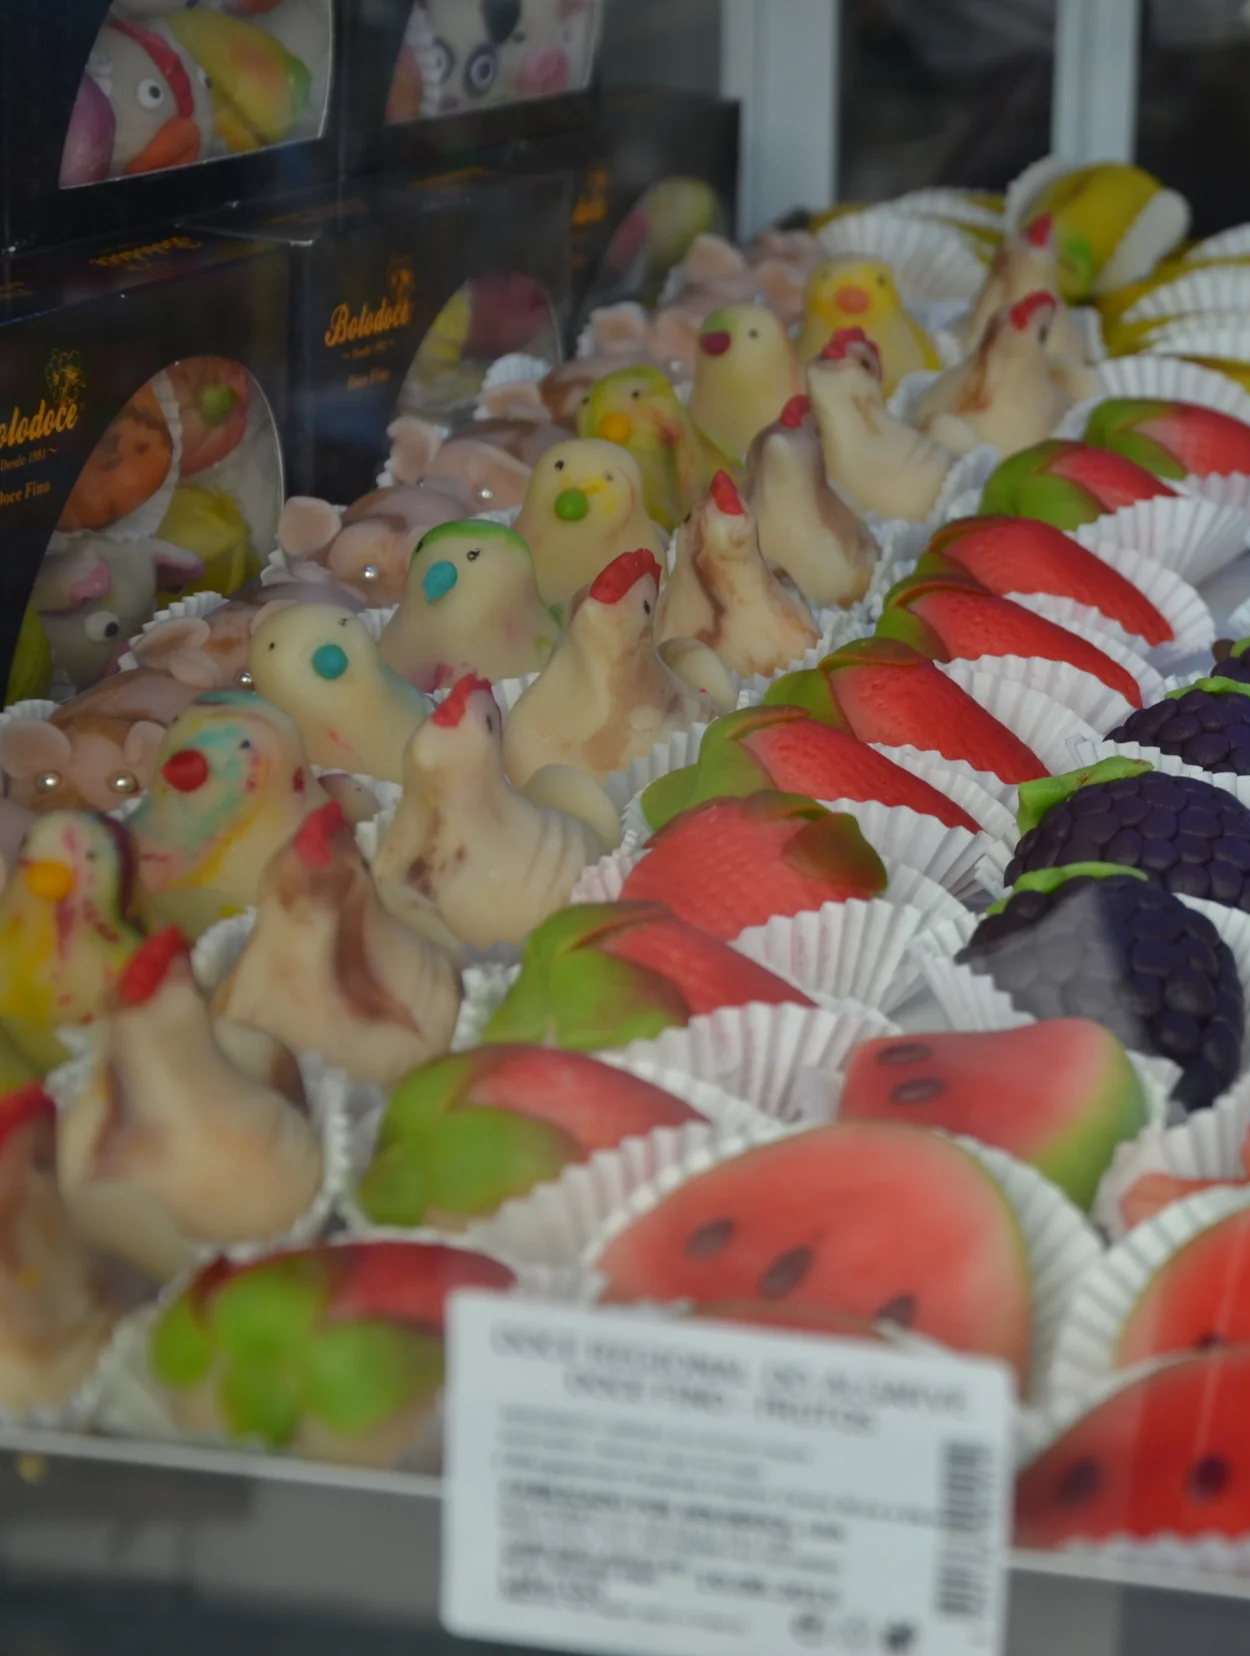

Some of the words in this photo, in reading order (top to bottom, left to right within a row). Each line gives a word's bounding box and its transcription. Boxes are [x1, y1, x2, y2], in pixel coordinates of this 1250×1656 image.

[326, 297, 409, 346] Bolodoce
[0, 399, 77, 449] olodoce
[25, 481, 50, 499] Fino
